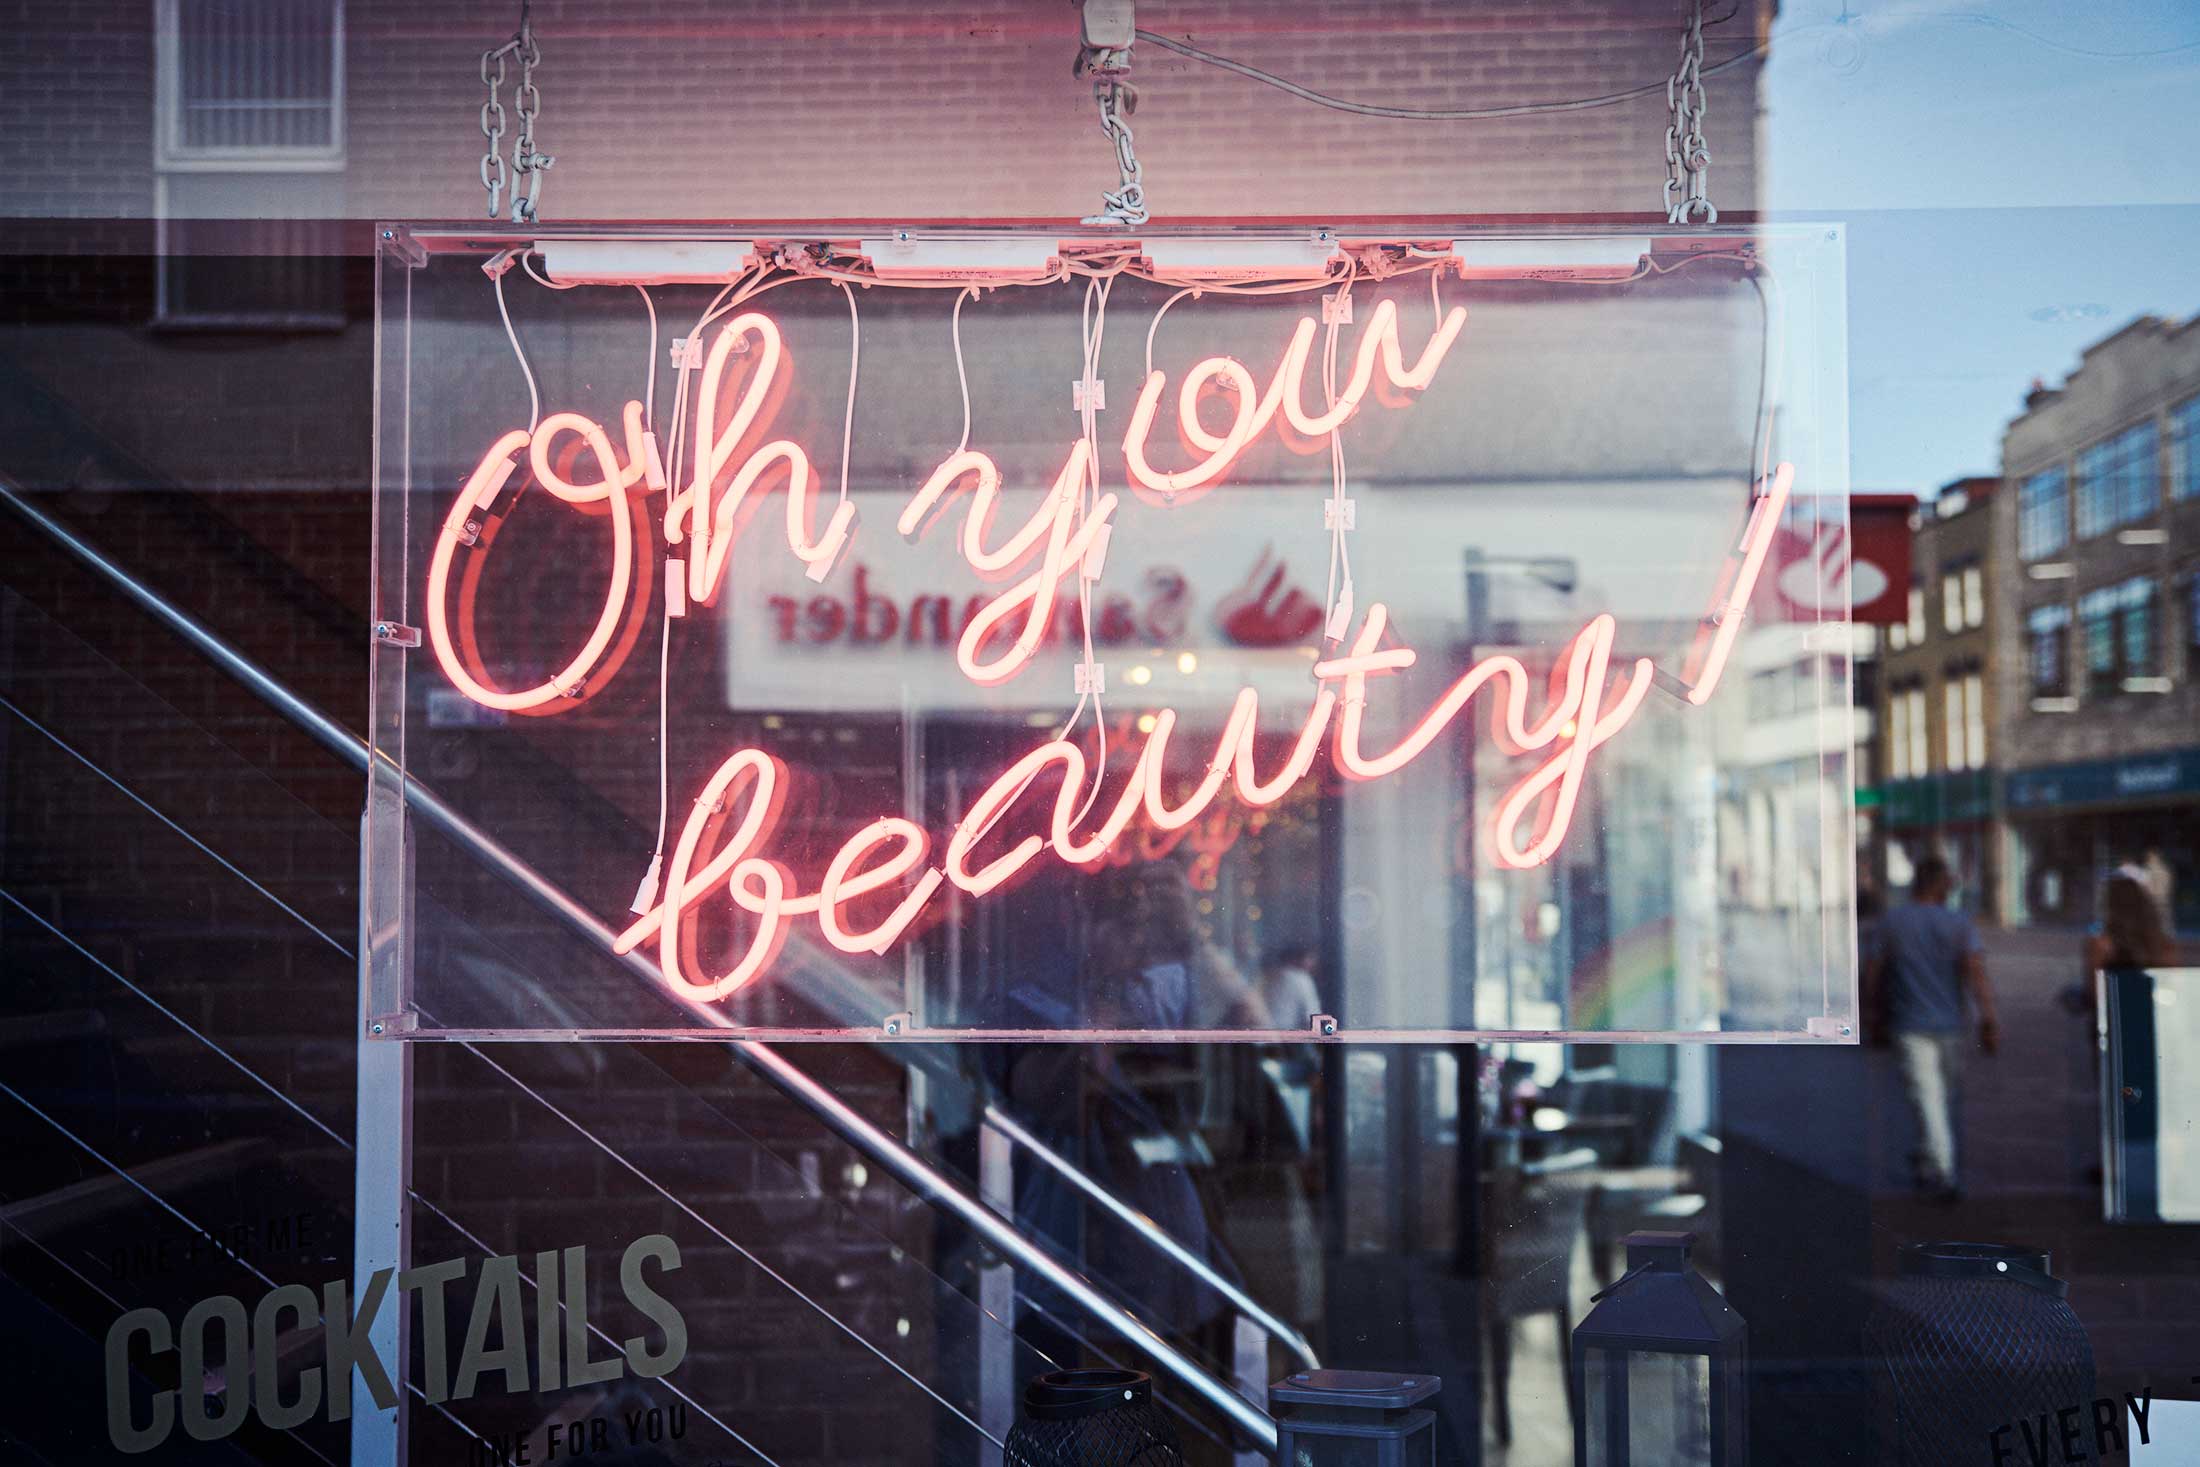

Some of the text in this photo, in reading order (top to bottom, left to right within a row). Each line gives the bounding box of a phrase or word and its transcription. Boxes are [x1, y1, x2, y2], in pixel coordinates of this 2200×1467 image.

[428, 297, 1467, 709] Oh you
[105, 1234, 688, 1454] COCKTAILS
[469, 1402, 687, 1467] ONE FOR YOU
[1990, 1387, 2152, 1467] EVERY
